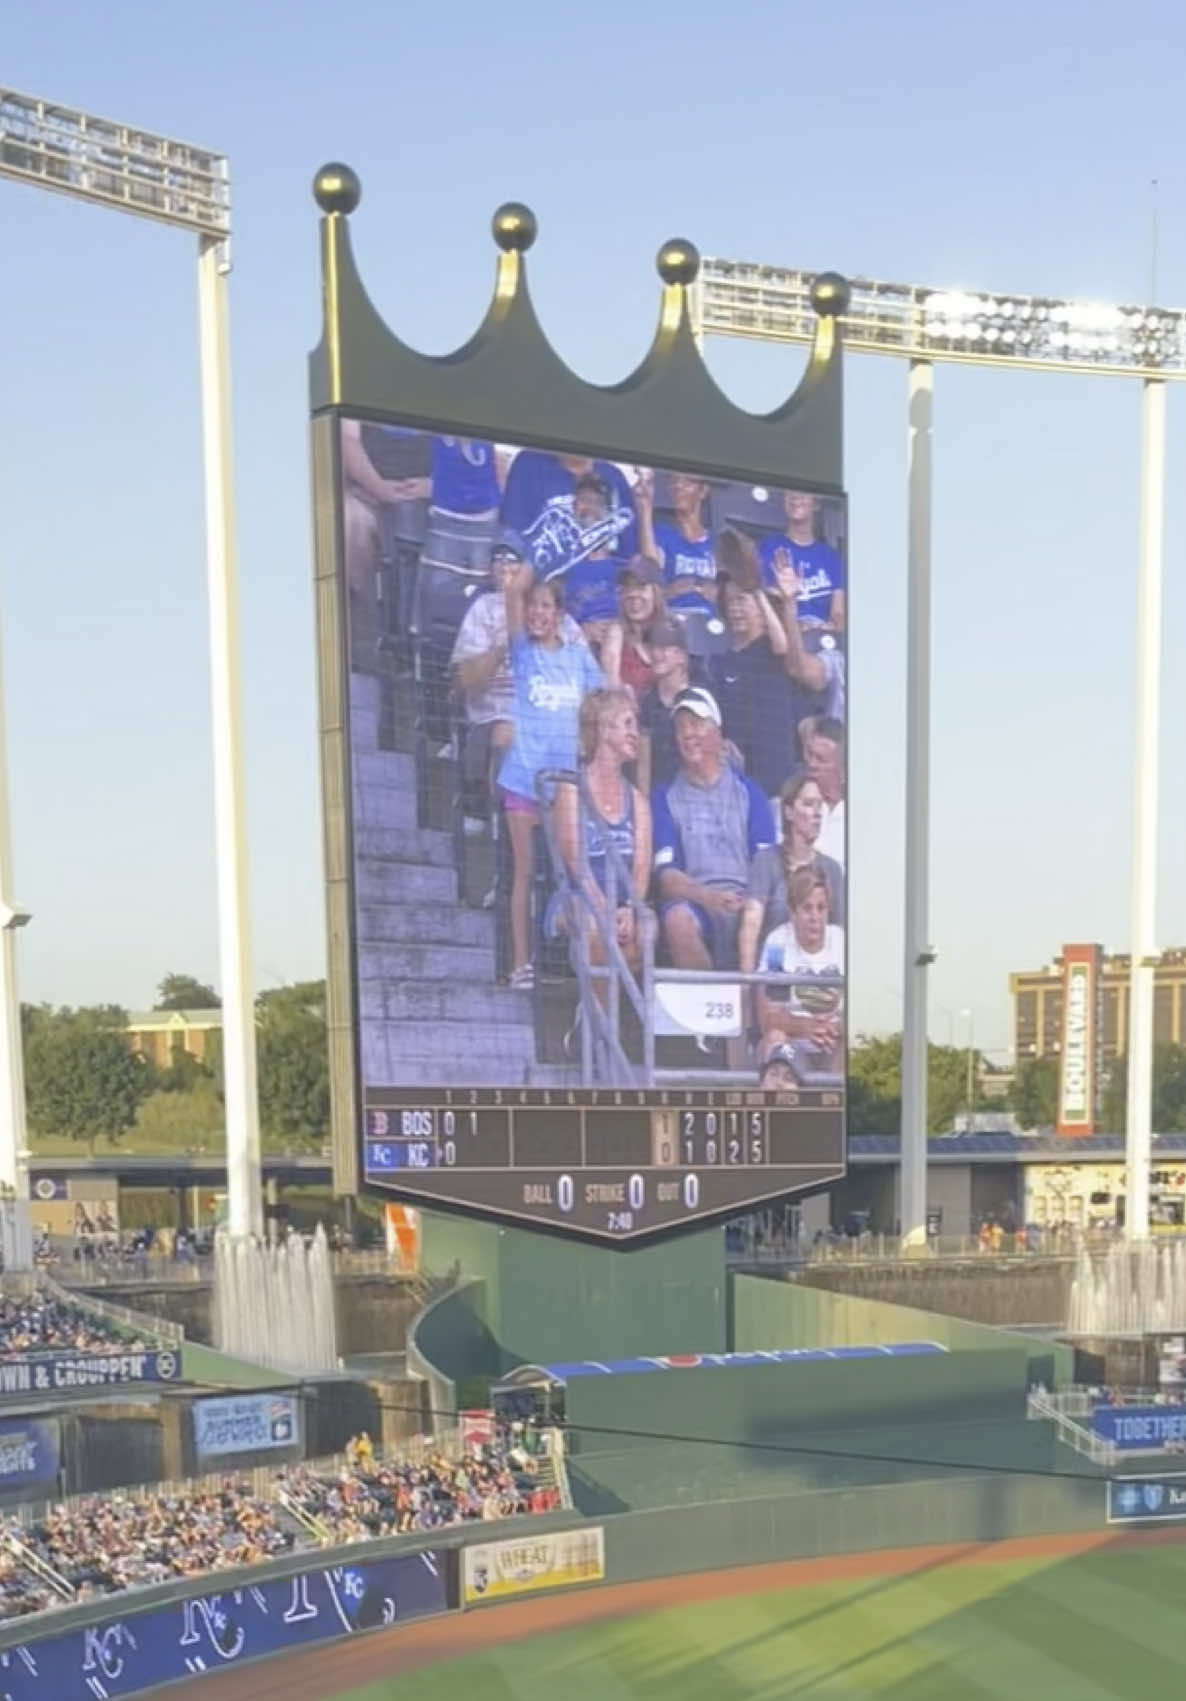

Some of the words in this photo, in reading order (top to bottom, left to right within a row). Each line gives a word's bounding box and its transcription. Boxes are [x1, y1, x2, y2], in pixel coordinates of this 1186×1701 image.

[705, 1002, 735, 1021] 238
[401, 1111, 433, 1136] BOS
[443, 1111, 455, 1136] 0
[470, 1111, 478, 1136] 1
[684, 1112, 694, 1136] 2
[706, 1112, 716, 1136] 0
[731, 1113, 738, 1136] 1
[751, 1113, 761, 1136] 5
[407, 1143, 429, 1168] KC
[445, 1141, 456, 1166] 0
[686, 1141, 694, 1164] 1
[706, 1141, 716, 1164] 0
[729, 1141, 739, 1164] 2
[751, 1141, 761, 1163] 5
[523, 1183, 552, 1205] BALL
[558, 1174, 574, 1212] 0
[585, 1183, 625, 1203] STRIKE
[629, 1173, 644, 1210] 0
[656, 1182, 679, 1202] OUT
[684, 1172, 699, 1209] 0
[501, 1546, 549, 1568] WHEAT
